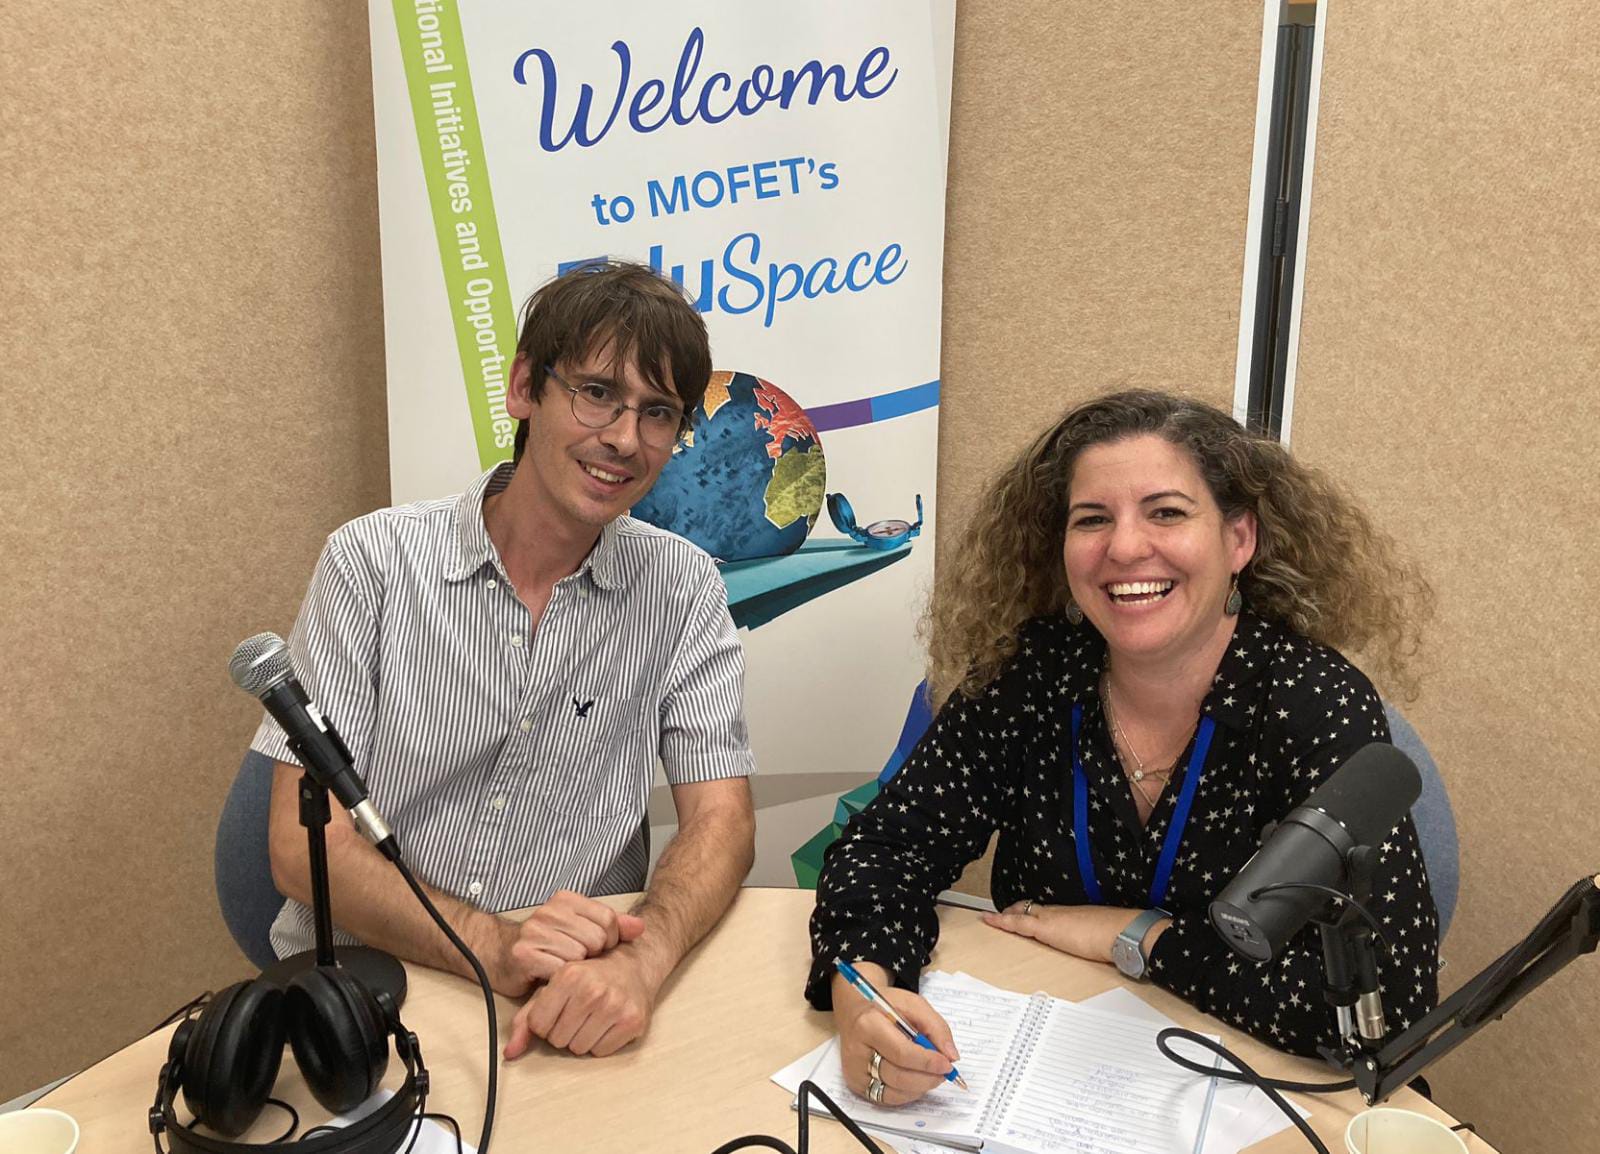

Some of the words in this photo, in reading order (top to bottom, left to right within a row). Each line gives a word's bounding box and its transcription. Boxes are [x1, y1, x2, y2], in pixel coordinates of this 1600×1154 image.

[512, 26, 899, 152] Welcome
[429, 81, 474, 214] Initiatives
[591, 193, 635, 226] to
[646, 156, 840, 218] MOFET's
[455, 221, 490, 272] and
[557, 231, 909, 328] uSpace
[463, 277, 515, 449] Opportunities
